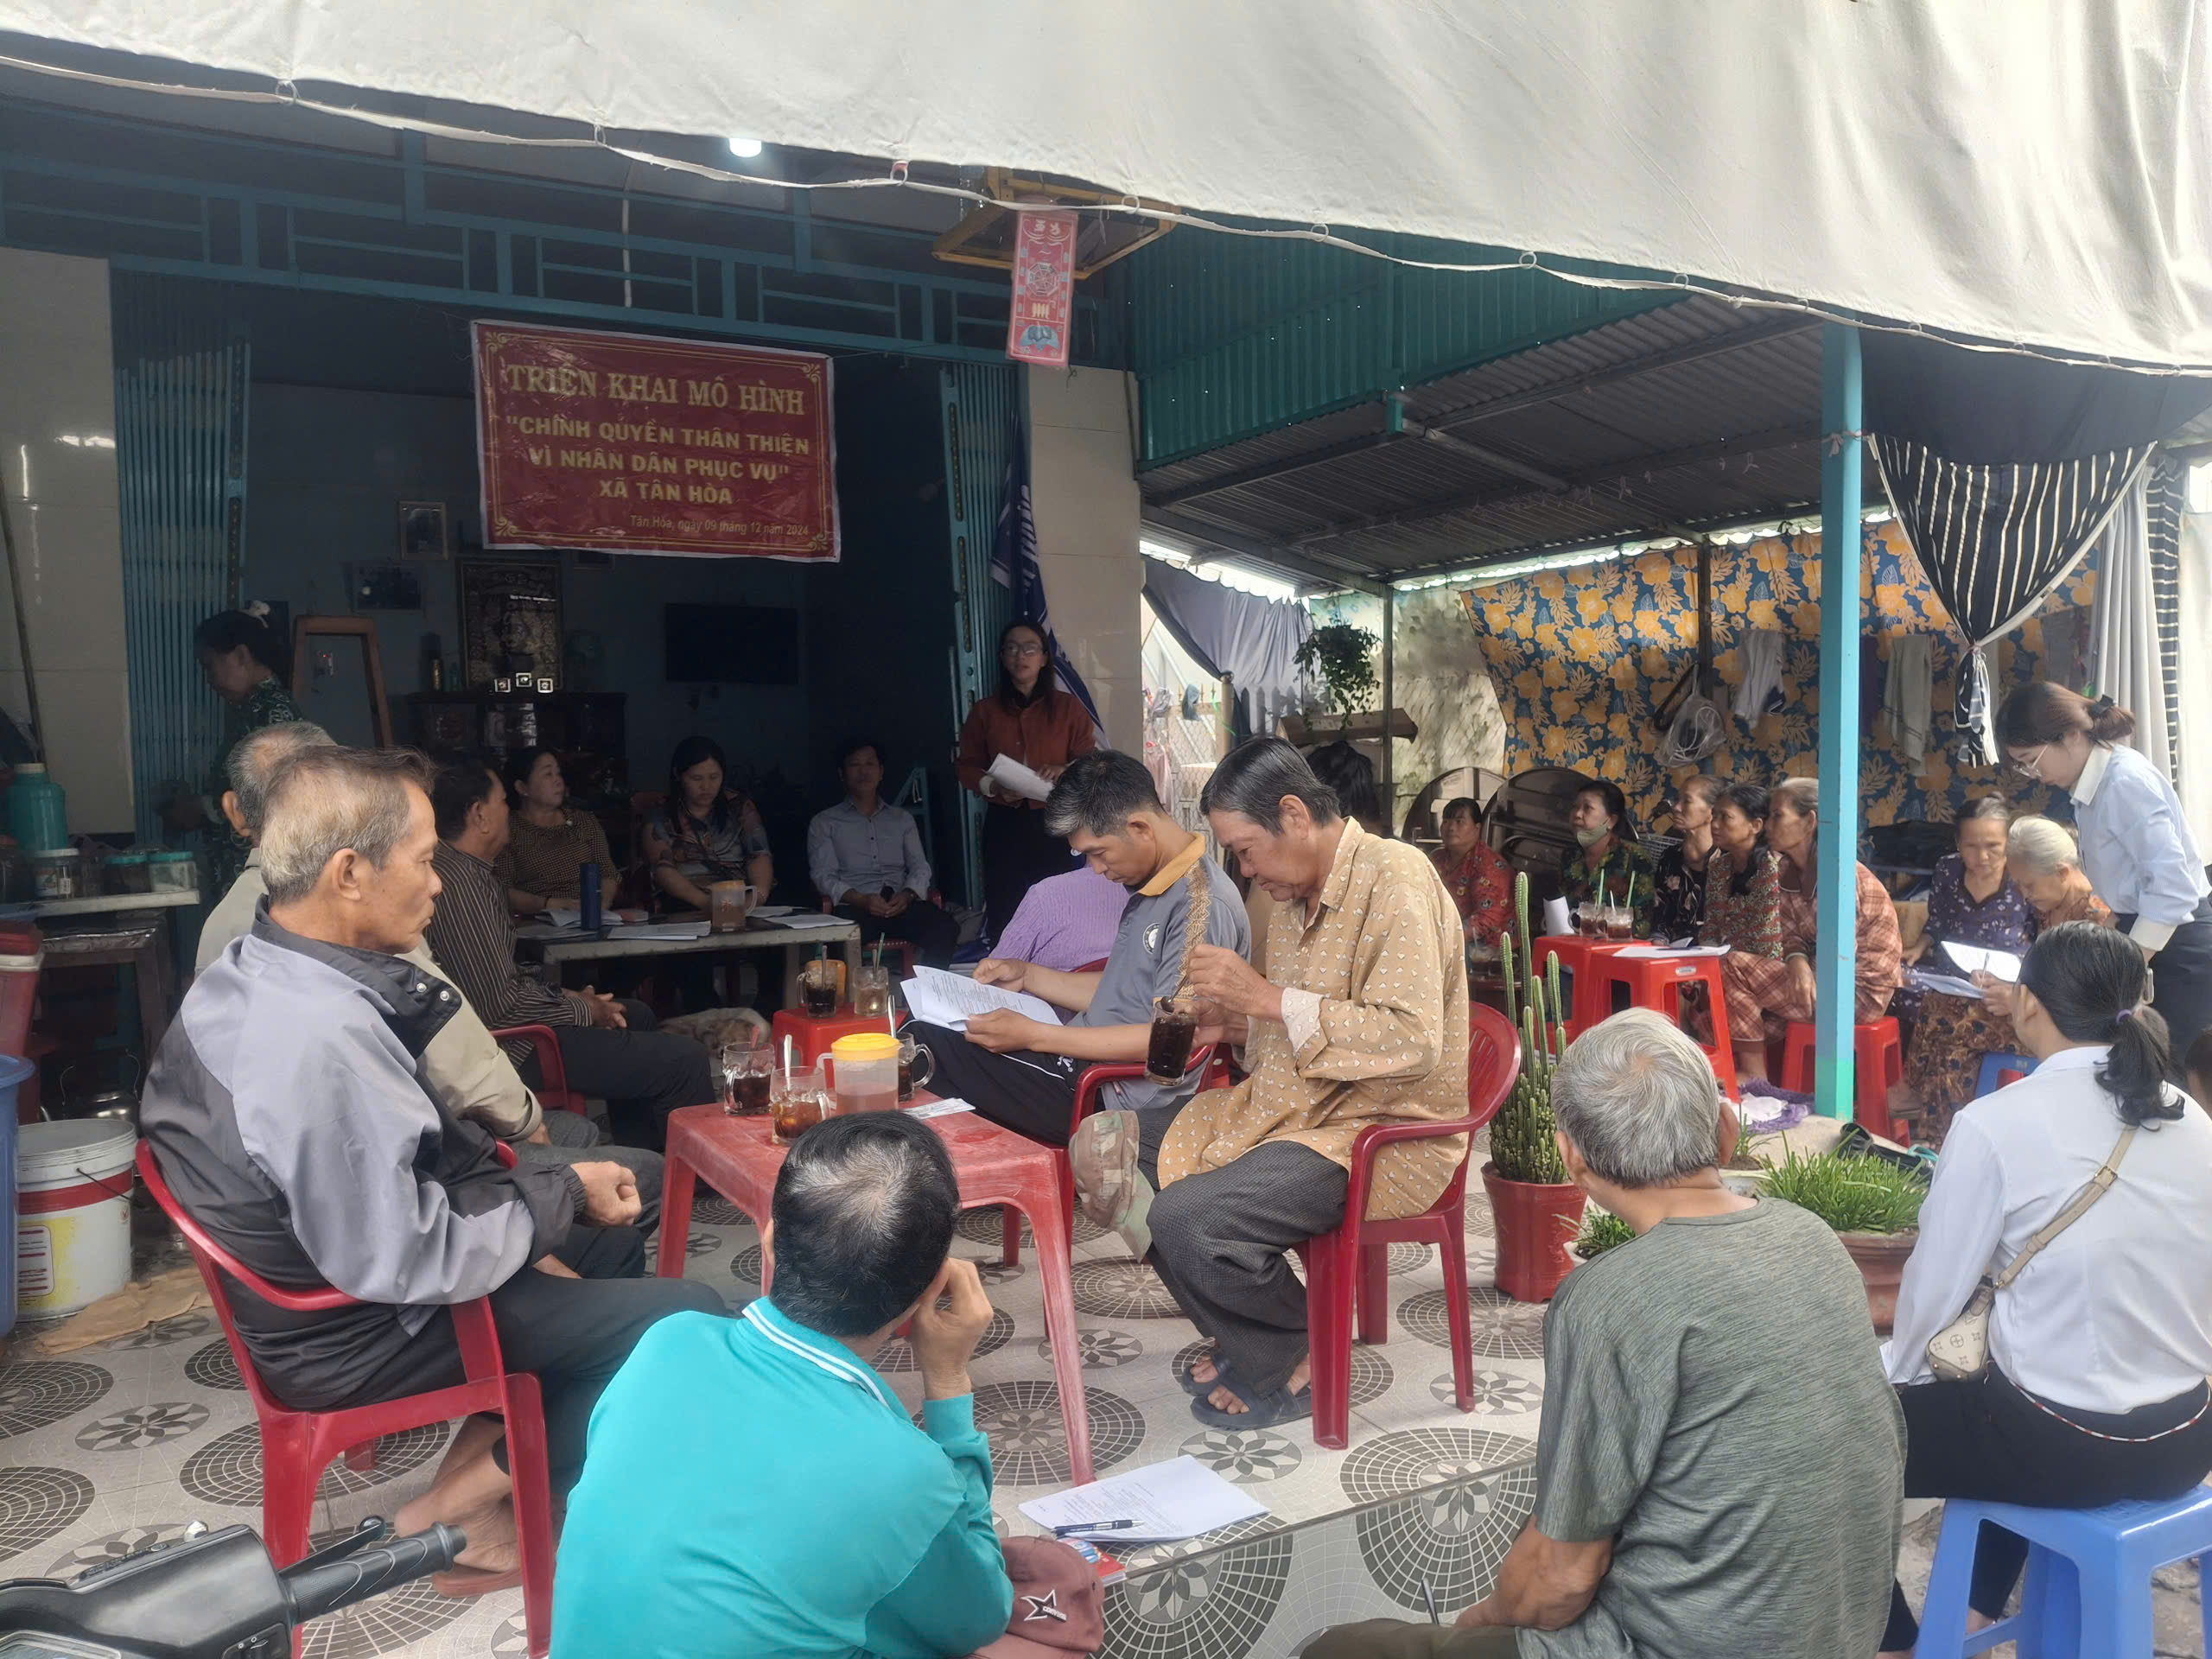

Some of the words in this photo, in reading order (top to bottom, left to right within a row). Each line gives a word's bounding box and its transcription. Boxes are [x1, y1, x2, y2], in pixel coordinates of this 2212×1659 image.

[607, 372, 678, 404] KHAI
[687, 375, 728, 408] MÔ
[738, 379, 805, 415] HÌNH
[599, 419, 674, 443] QUYỀN
[680, 427, 740, 449] THÂN
[747, 433, 809, 456] THIỆN
[529, 444, 552, 467] VÌ
[560, 447, 624, 470] NHÂN
[632, 451, 677, 474] DÂN
[684, 458, 743, 480] PHỤC
[749, 462, 789, 484] VỤ"
[600, 476, 628, 498] XÃ
[636, 479, 681, 501] TÂN
[689, 482, 733, 505] HÒA
[630, 515, 647, 527] Tân
[677, 518, 702, 533] ngày
[704, 518, 717, 531] 09
[719, 520, 747, 535] tháng
[750, 521, 761, 533] 12
[765, 522, 783, 535] năm
[786, 524, 809, 536] 2024
